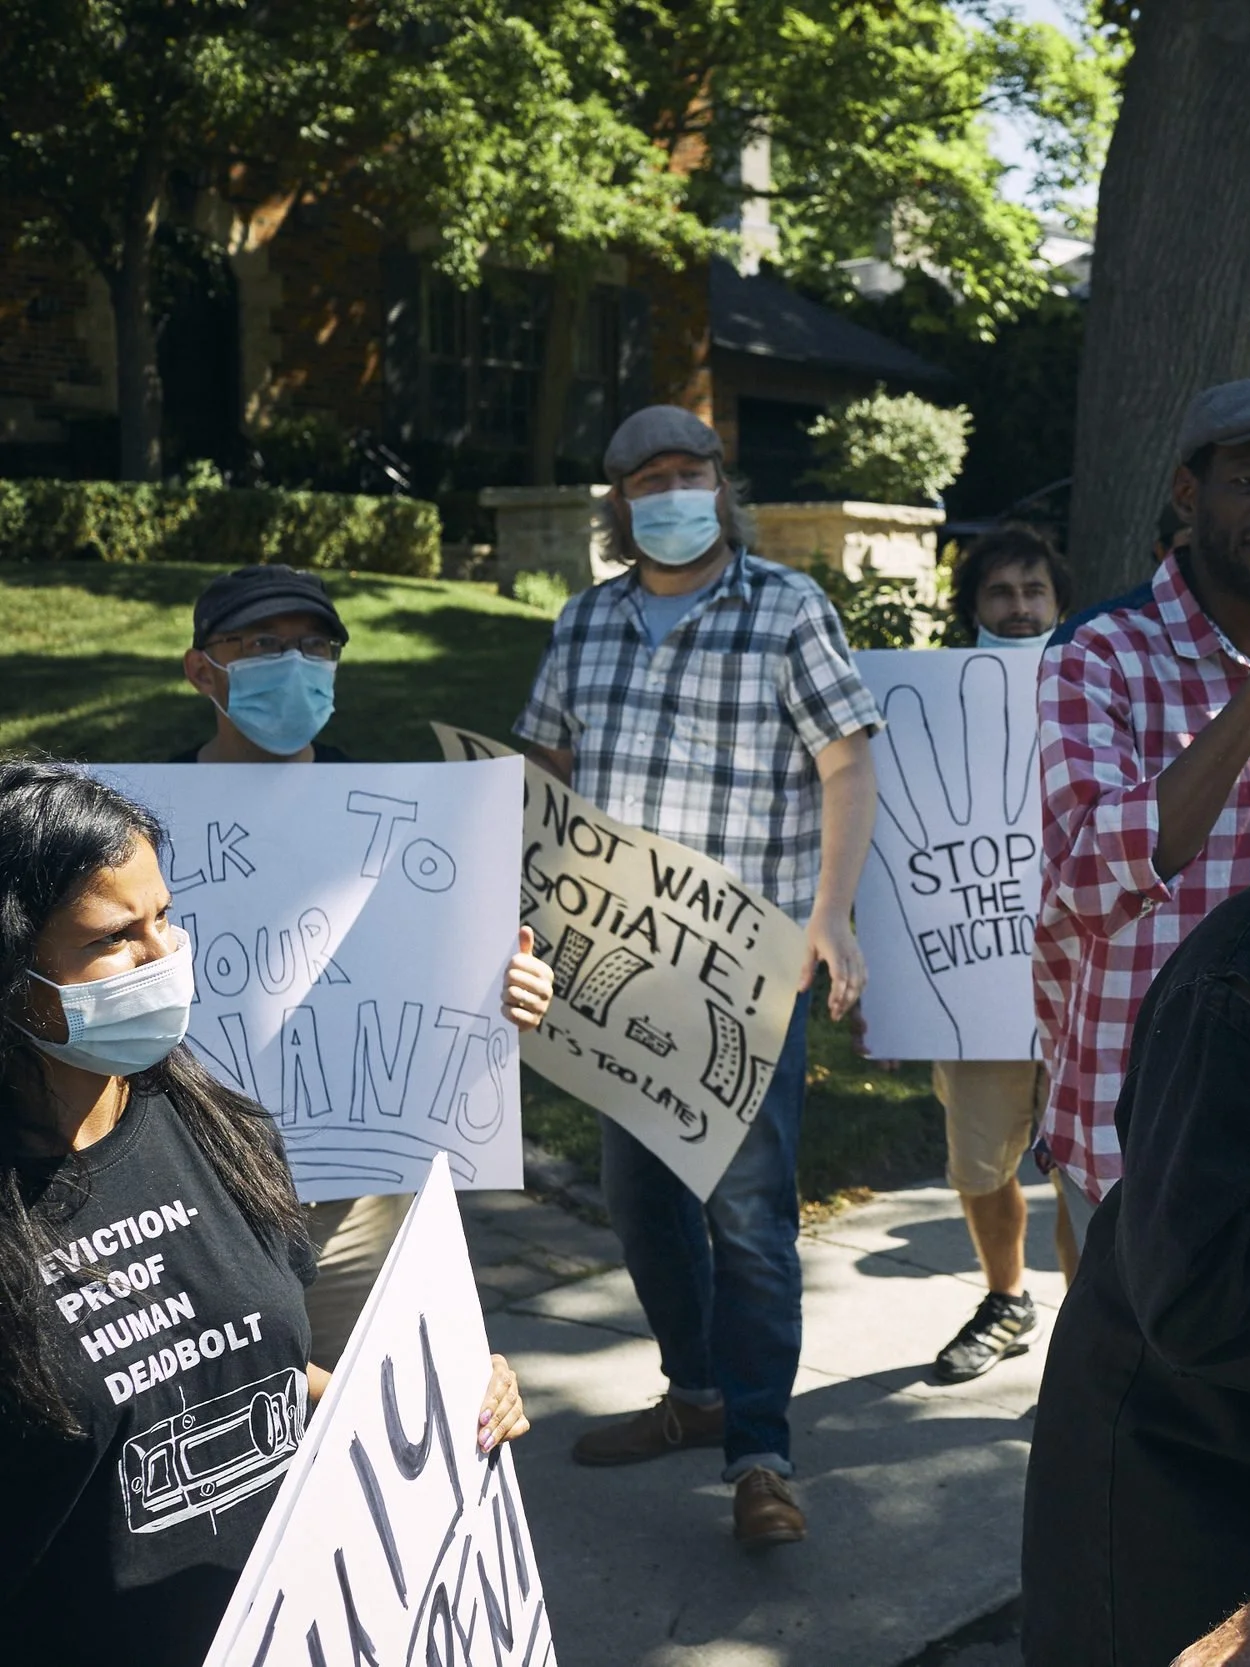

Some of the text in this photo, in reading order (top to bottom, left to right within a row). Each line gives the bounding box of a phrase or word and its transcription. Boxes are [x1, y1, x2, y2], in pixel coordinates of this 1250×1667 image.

[347, 790, 456, 892] TO
[543, 782, 637, 864] NOT
[909, 832, 1036, 895] STOP
[950, 879, 1026, 919] THE
[37, 1199, 199, 1286] EVICTION-
[55, 1254, 166, 1324] PROOF
[80, 1292, 196, 1363] HUMAN
[104, 1312, 262, 1405] DEADBOLT
